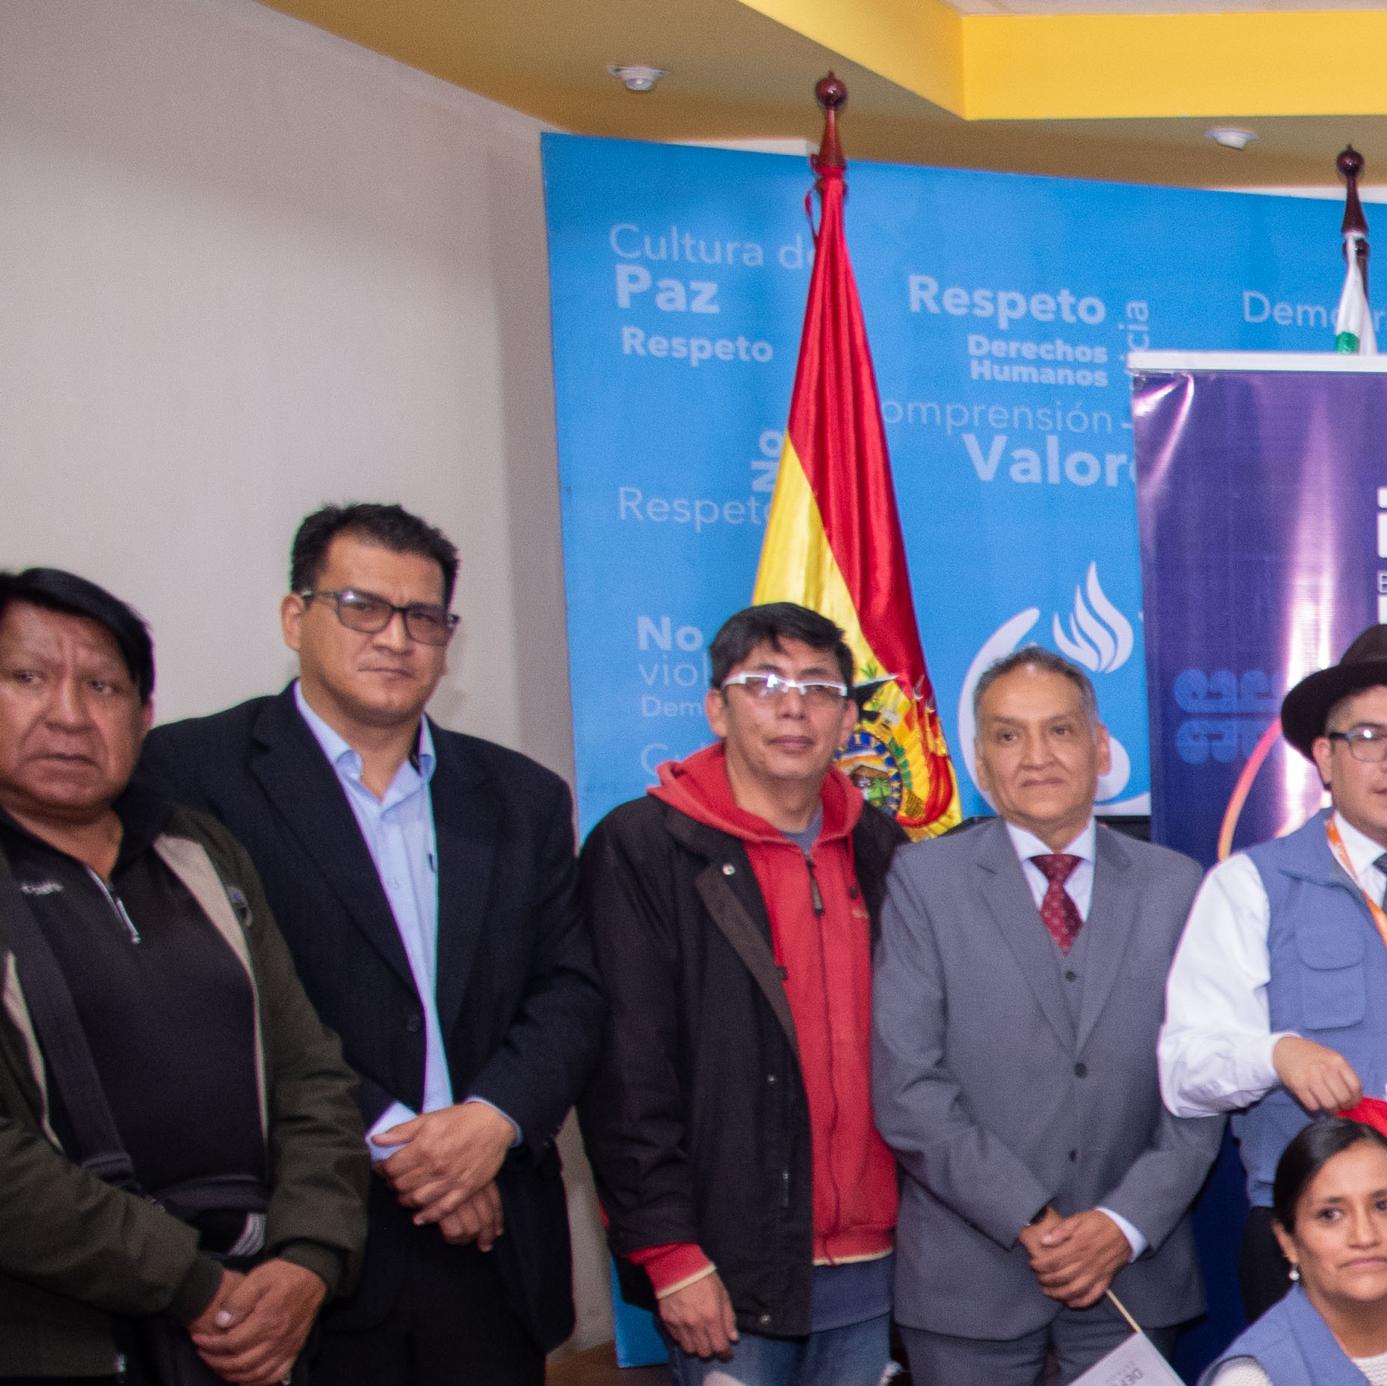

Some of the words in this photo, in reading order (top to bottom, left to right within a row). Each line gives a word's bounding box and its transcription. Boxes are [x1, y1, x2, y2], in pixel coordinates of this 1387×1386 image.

[609, 223, 764, 267] Cultura
[614, 263, 720, 314] Paz
[908, 273, 1106, 331] Respeto
[622, 325, 774, 368] Respeto
[967, 333, 1109, 363] Derechos
[970, 359, 1109, 387] Humanos
[881, 399, 1112, 435] omprensión
[961, 432, 1136, 488] Valor
[637, 615, 704, 651] No
